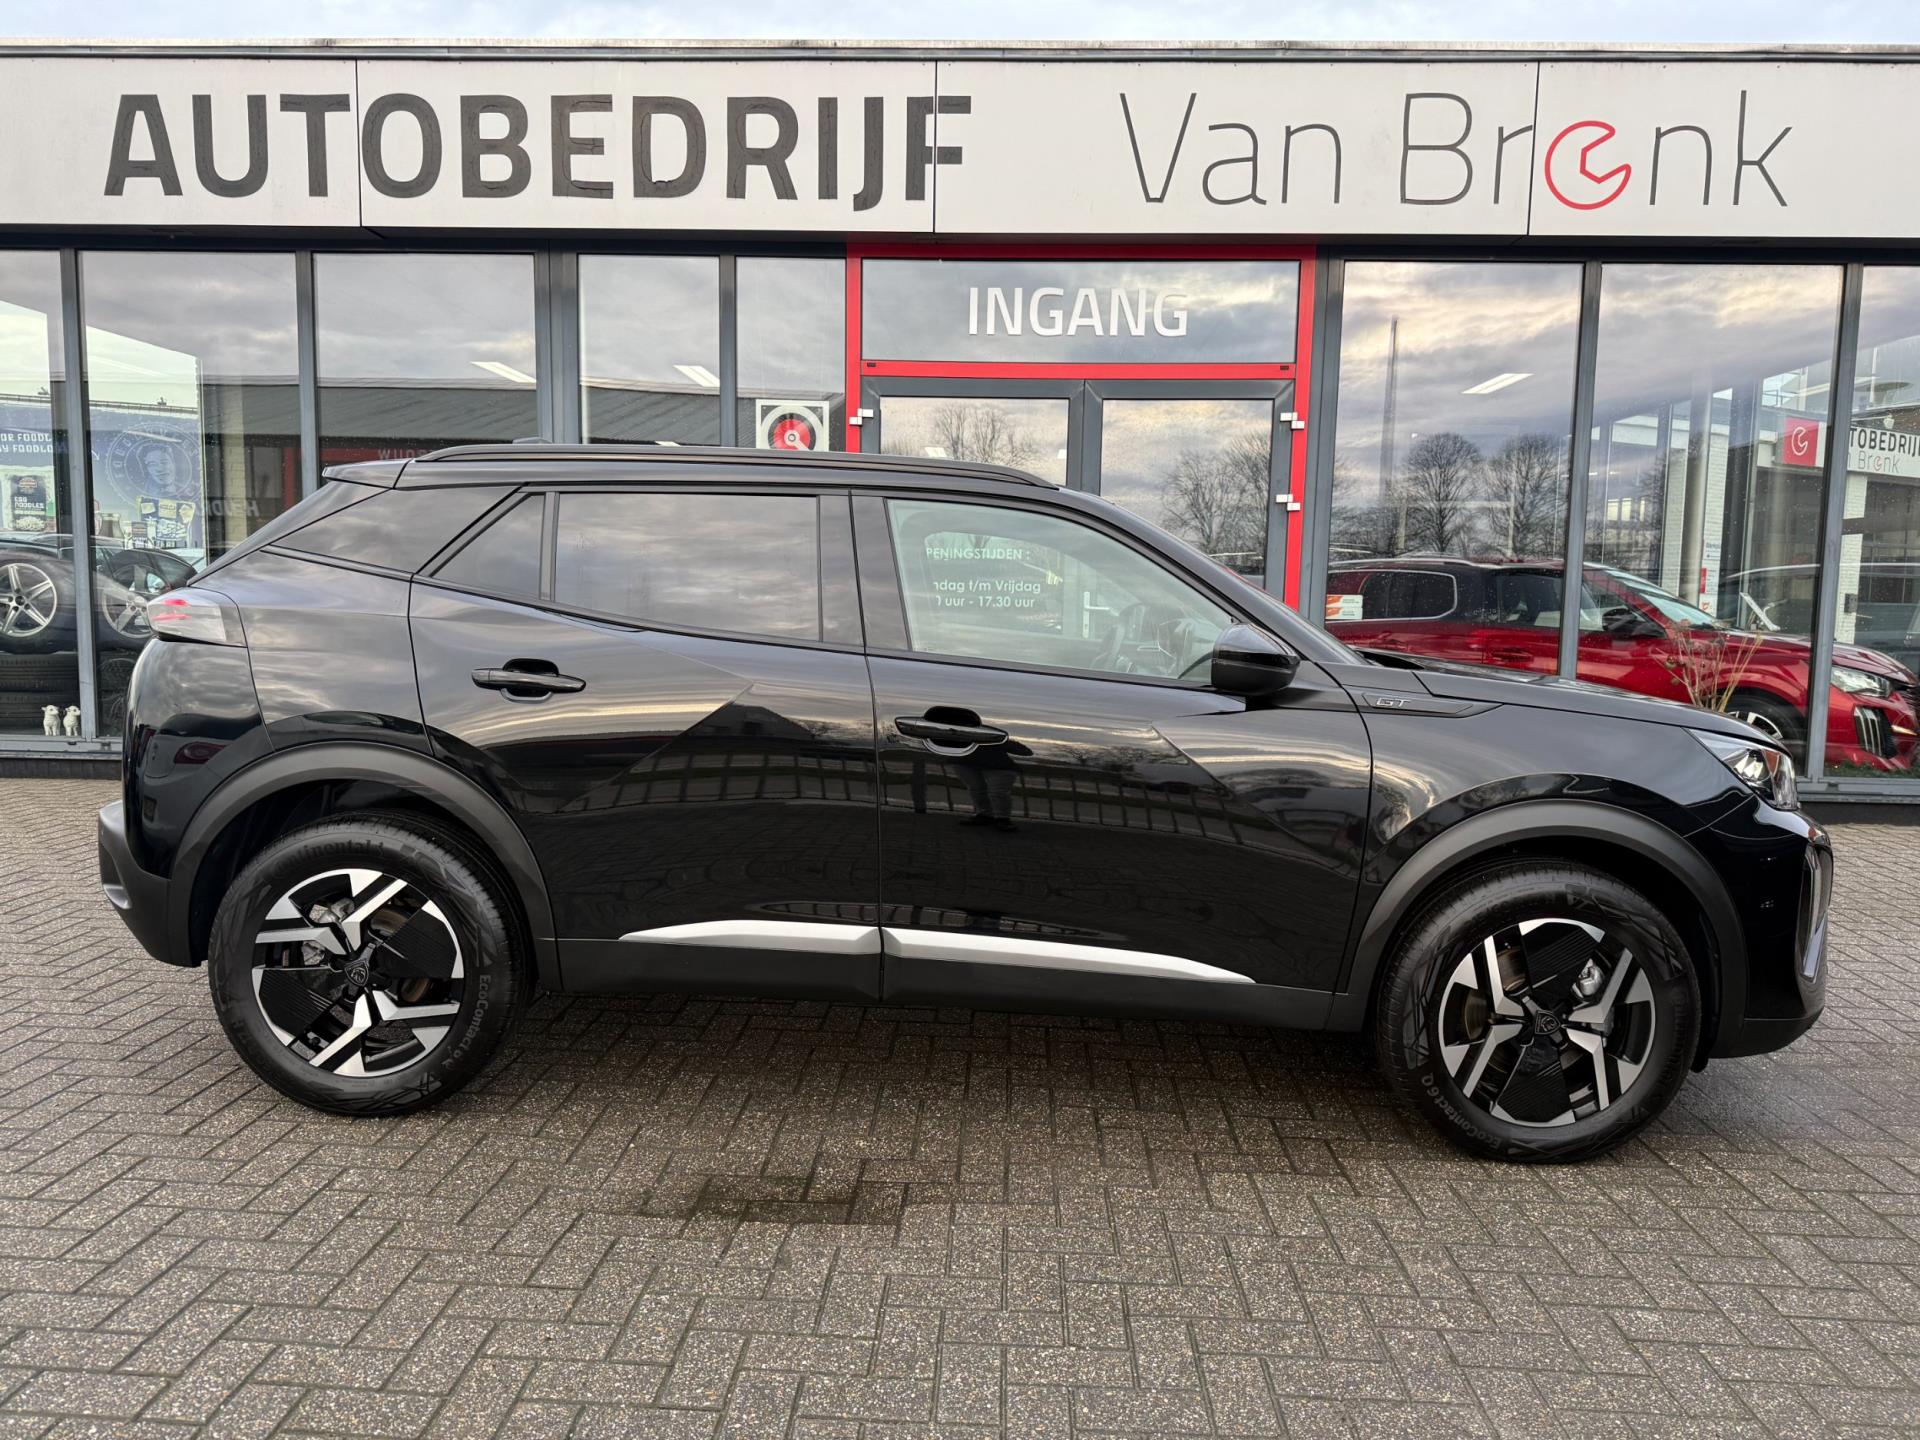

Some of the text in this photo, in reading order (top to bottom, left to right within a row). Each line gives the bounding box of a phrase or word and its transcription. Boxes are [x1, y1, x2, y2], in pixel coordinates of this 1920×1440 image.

[103, 92, 972, 213] AUTOBEDRIJF
[1119, 91, 1342, 206] Van
[968, 285, 1189, 338] INGANG
[1849, 428, 1920, 458] TOBEDRIJ
[945, 597, 966, 607] uur
[978, 596, 1011, 608] 17.30
[1014, 598, 1036, 608] uur
[968, 580, 992, 592] t/m
[995, 580, 1042, 594] Vrijdag
[1376, 697, 1411, 708] GT
[459, 974, 492, 1051] EcoContact
[1420, 1072, 1504, 1150] EcoContact 6 Q
